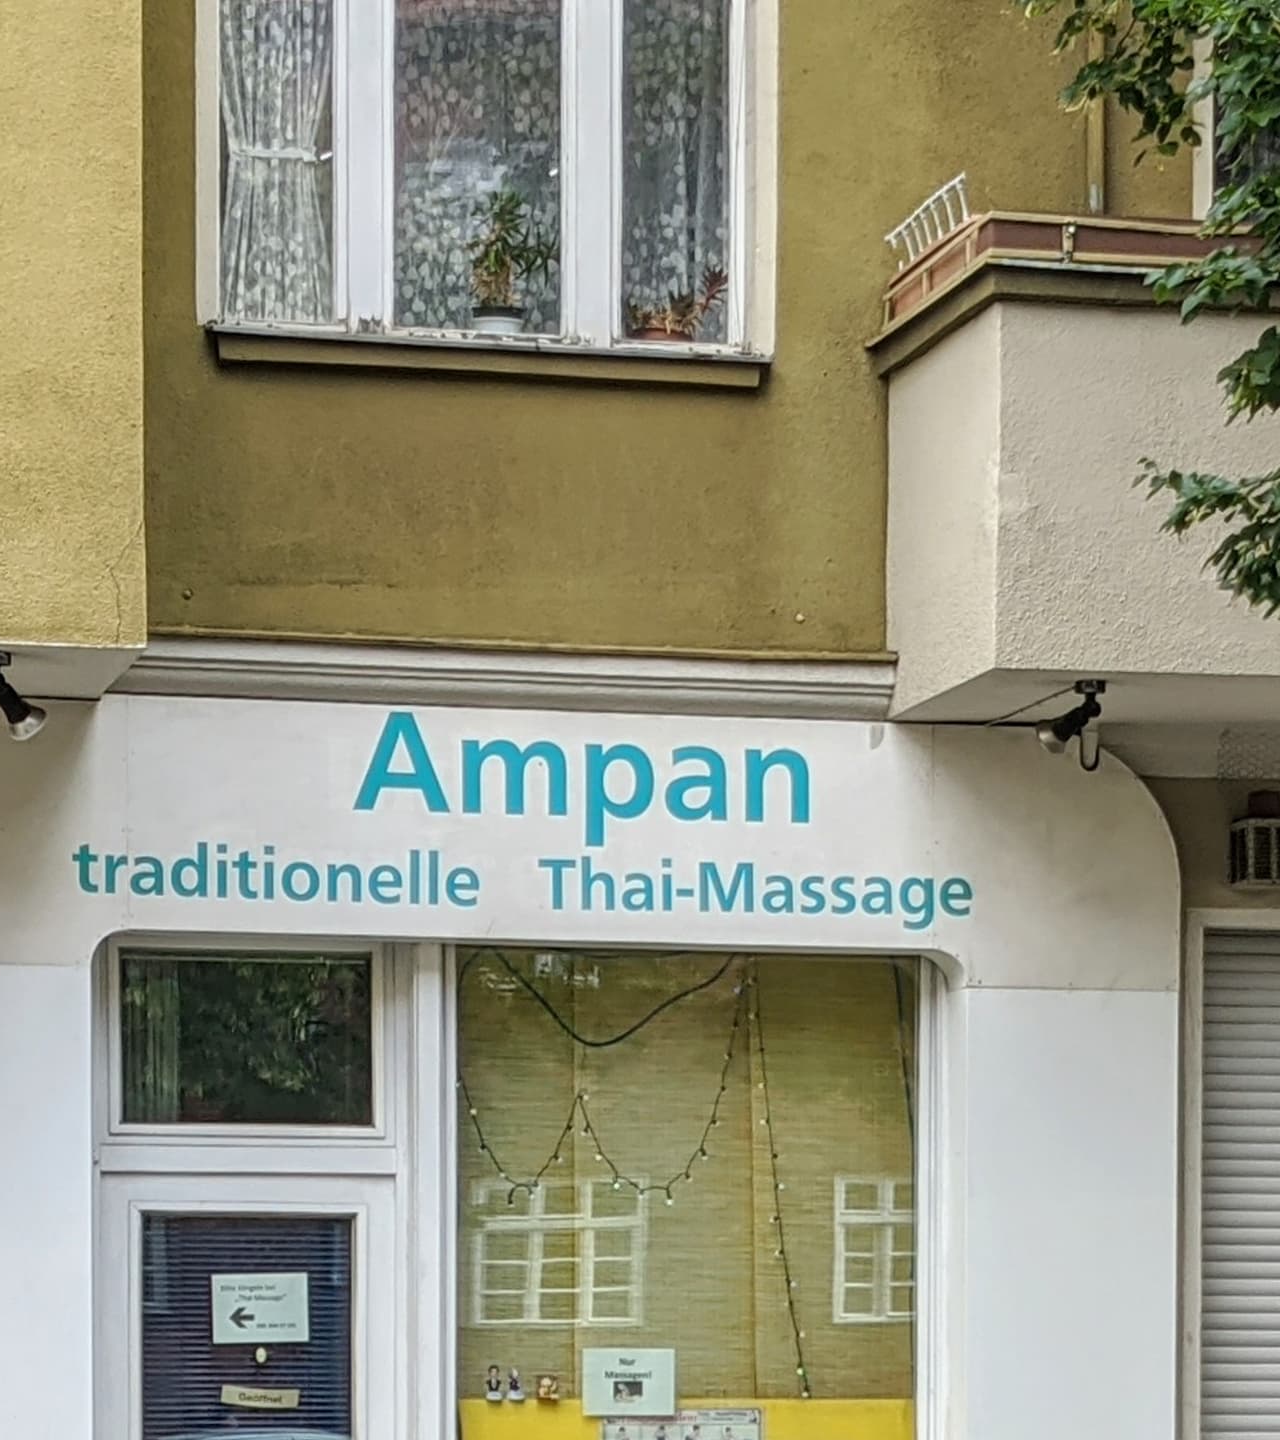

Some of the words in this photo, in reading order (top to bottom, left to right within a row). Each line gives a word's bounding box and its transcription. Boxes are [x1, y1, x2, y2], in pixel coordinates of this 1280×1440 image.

[354, 710, 812, 848] Ampan
[72, 843, 481, 909] traditionelle
[538, 857, 974, 931] Thai-Massage
[618, 1357, 636, 1367] Nur
